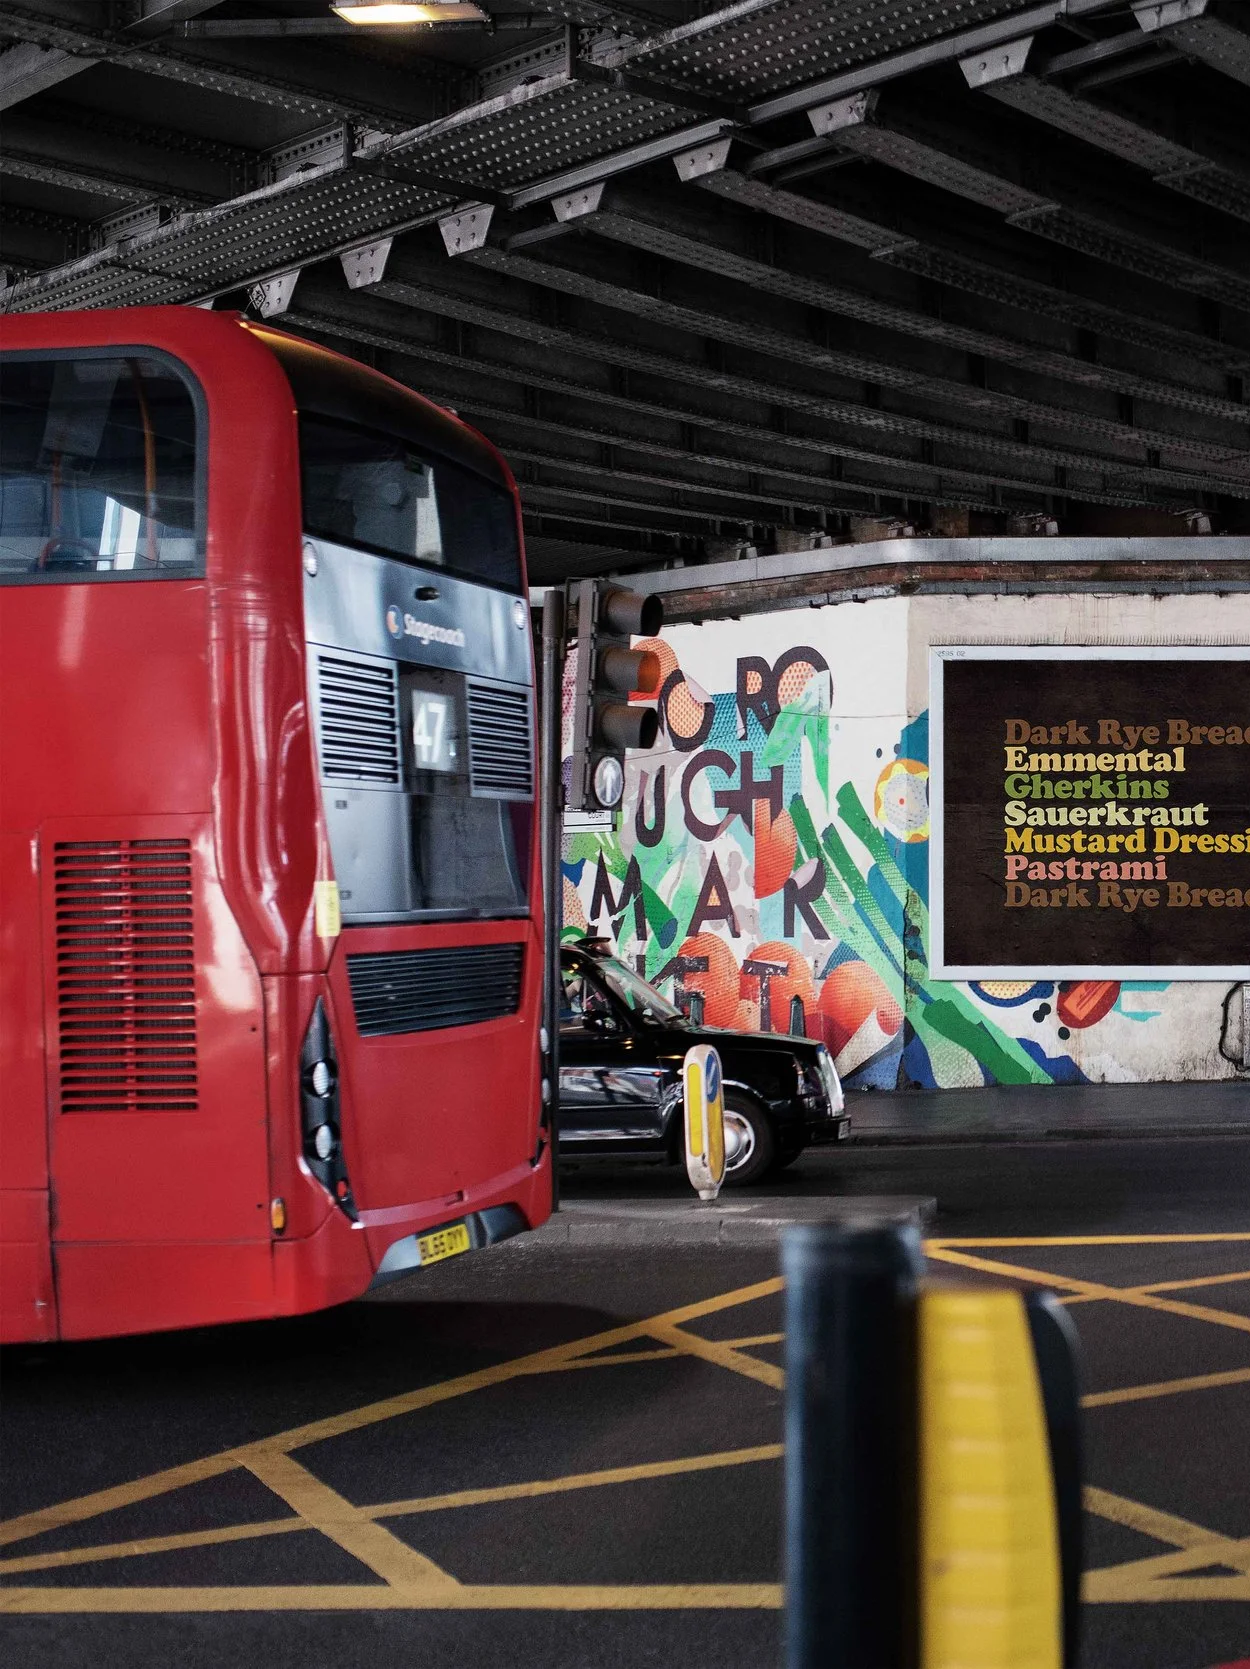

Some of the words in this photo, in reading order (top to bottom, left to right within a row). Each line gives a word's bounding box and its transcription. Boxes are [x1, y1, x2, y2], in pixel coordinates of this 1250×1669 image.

[413, 703, 446, 763] 47
[1004, 719, 1091, 744] Dark
[1097, 719, 1160, 750] Rye
[1004, 746, 1186, 772] Emmental
[636, 749, 785, 847] UGH
[1004, 773, 1169, 799] Gherkins
[1004, 801, 1208, 826] Sauerkraut
[1004, 827, 1146, 854] Mustard
[1004, 855, 1168, 880] Pastrami
[588, 848, 830, 941] MAR
[1004, 882, 1092, 907] Dark
[1097, 882, 1160, 912] Rye
